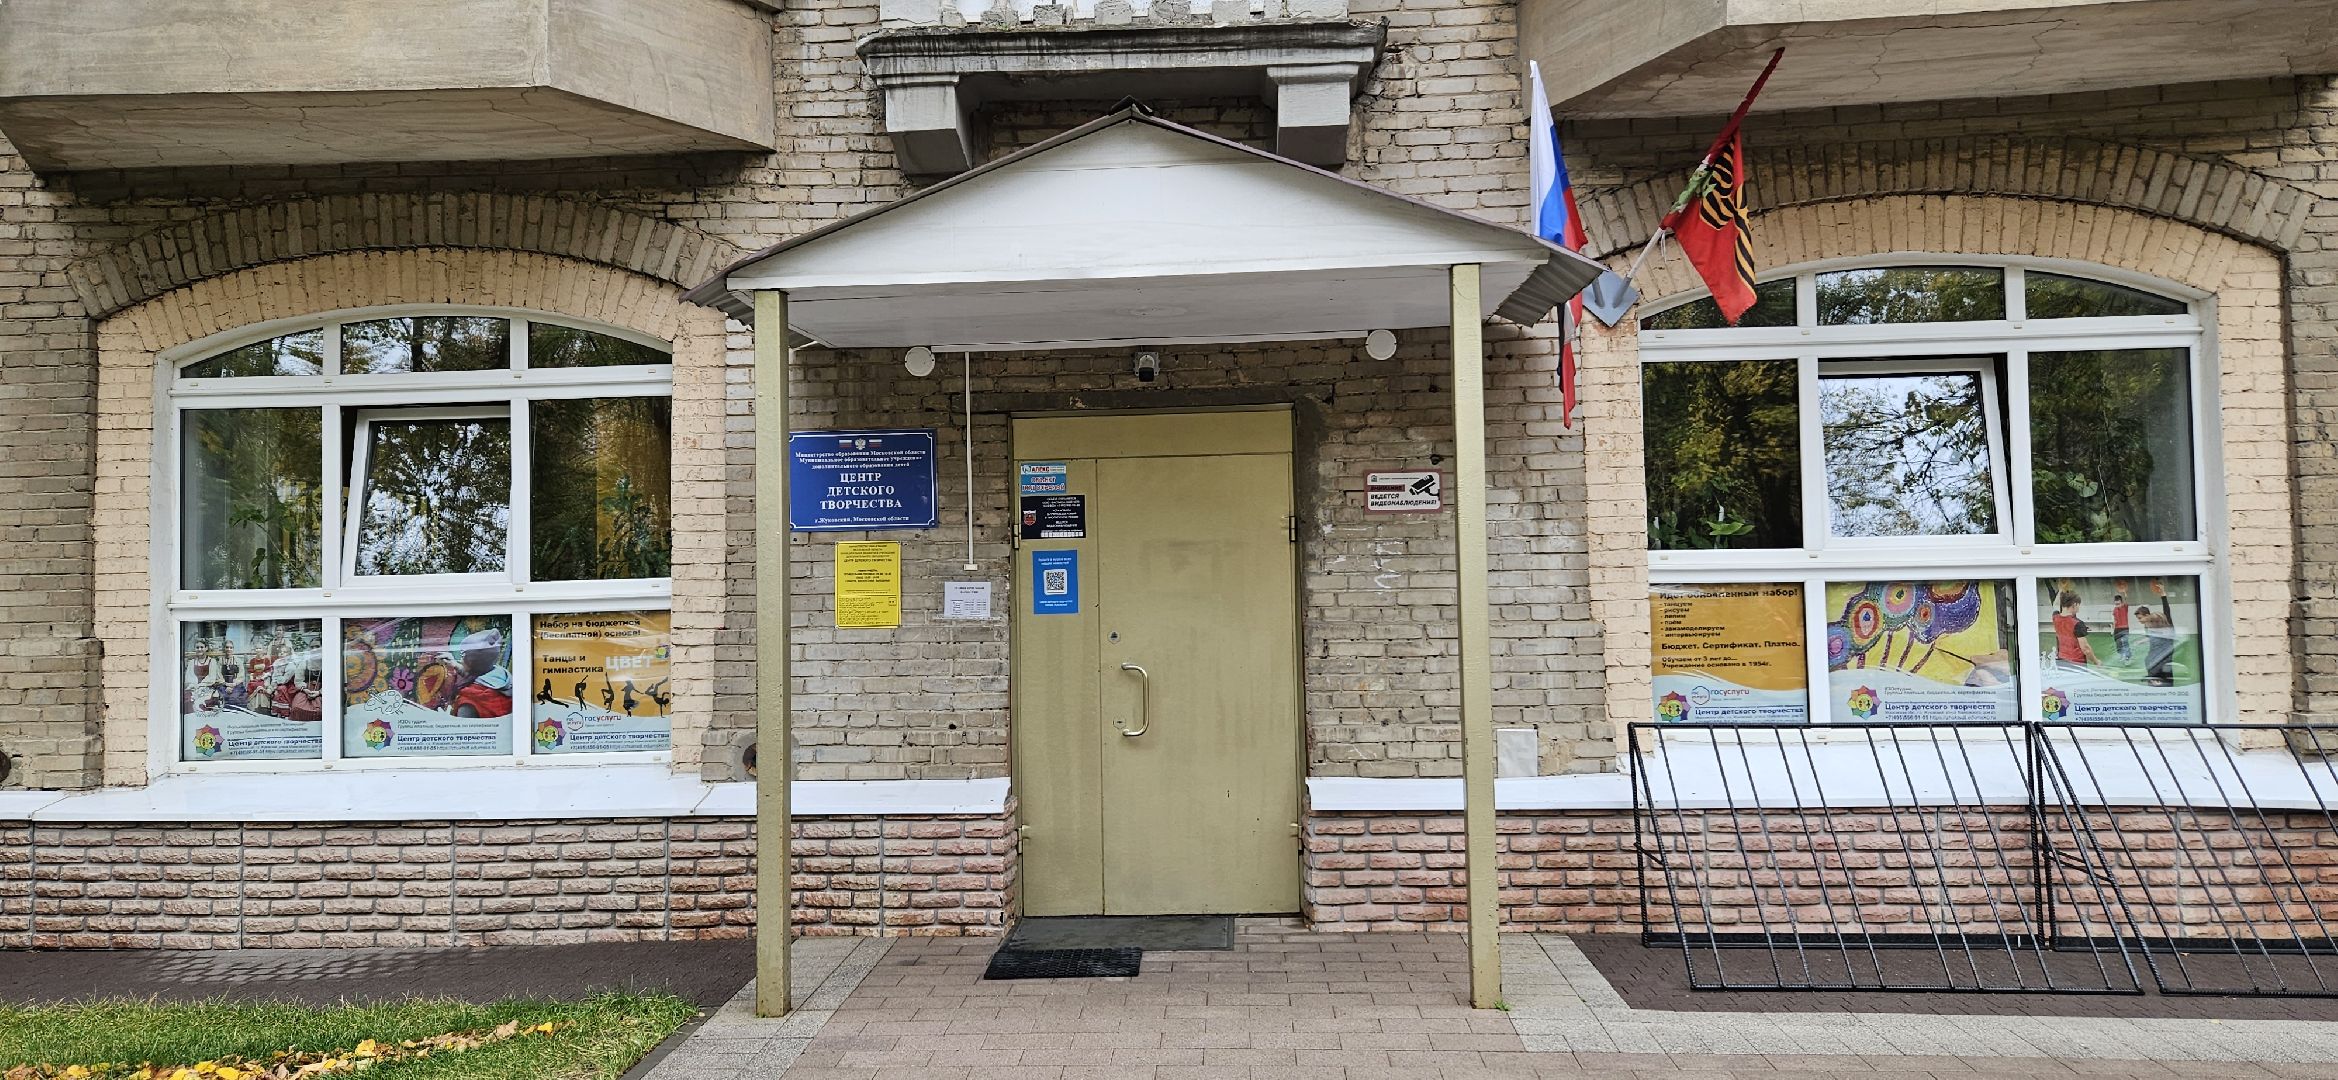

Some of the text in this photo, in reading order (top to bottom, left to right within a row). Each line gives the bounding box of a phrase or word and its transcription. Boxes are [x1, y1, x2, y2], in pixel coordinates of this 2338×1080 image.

[840, 473, 882, 484] ЦЕНТР
[827, 486, 895, 498] ДЕТСКОГО
[820, 500, 902, 510] ТВОРЧЕСТВА
[1762, 589, 1798, 597] набор!
[586, 619, 640, 627] бюджетной
[540, 630, 602, 640] (бесплатной)
[1702, 642, 1761, 650] Сертификат.
[543, 655, 576, 663] Танцы
[606, 656, 653, 670] ЦВЕТ
